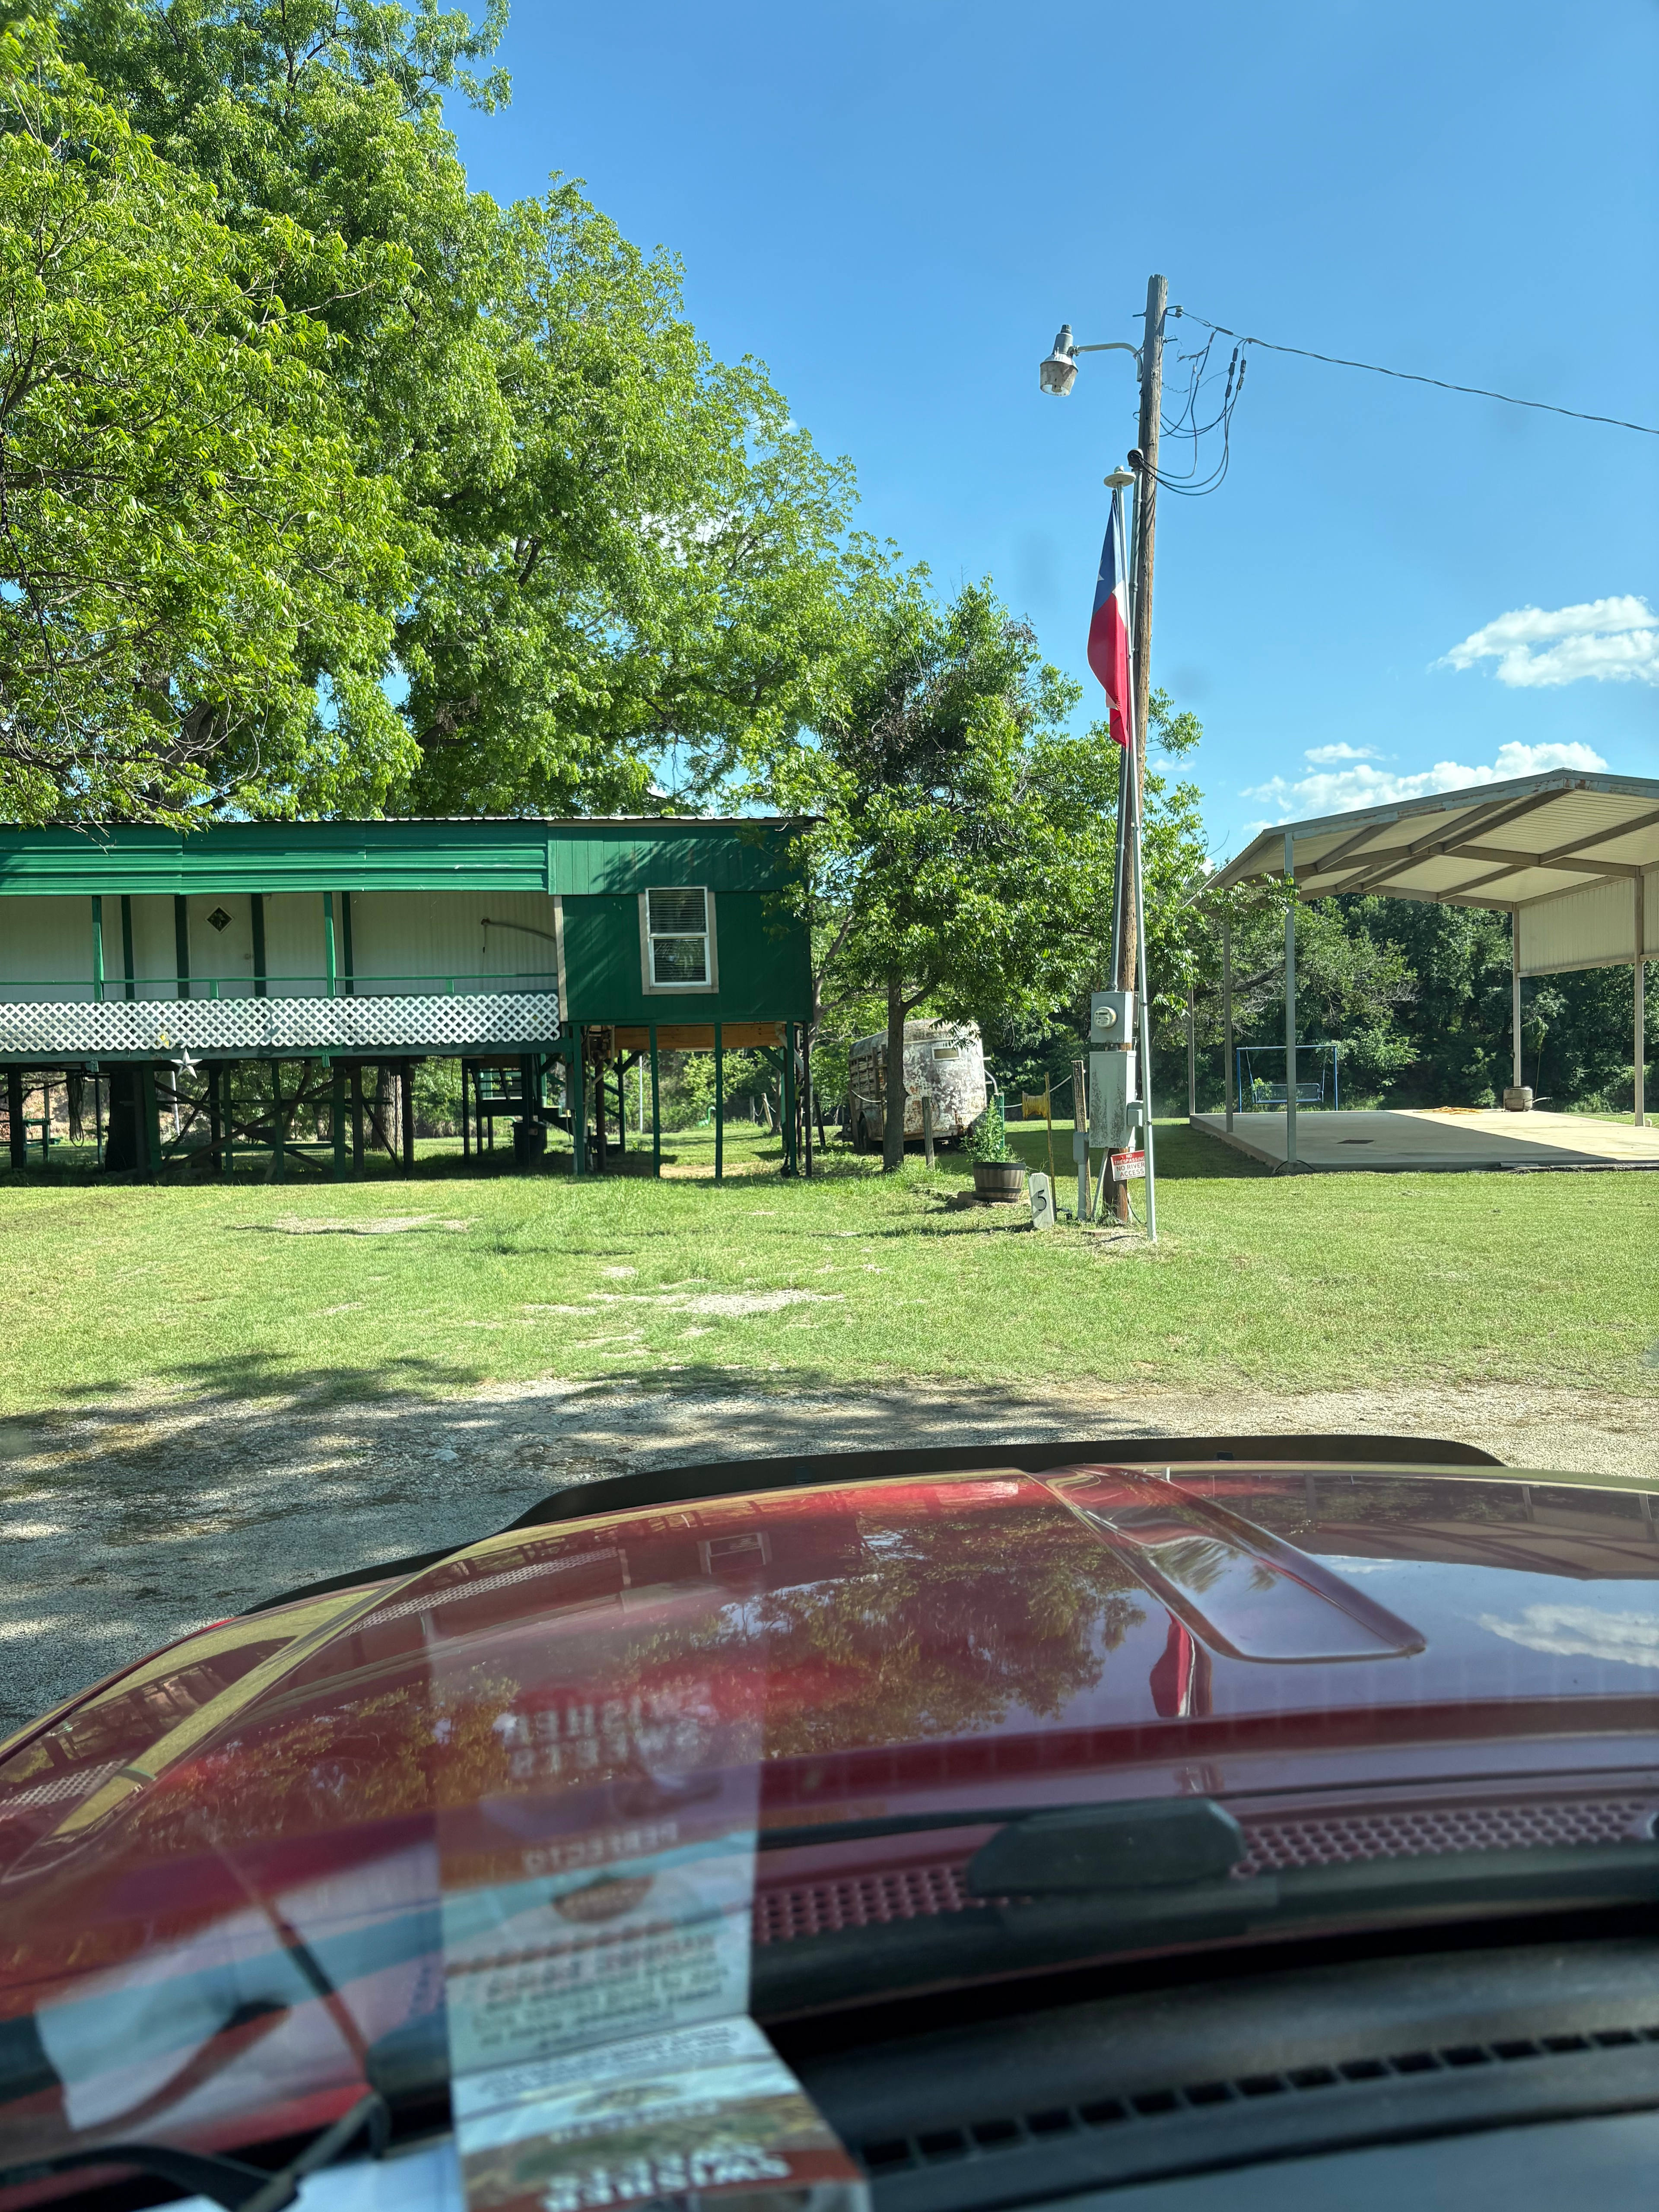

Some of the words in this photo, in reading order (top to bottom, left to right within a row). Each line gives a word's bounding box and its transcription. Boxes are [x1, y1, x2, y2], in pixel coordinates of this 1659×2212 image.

[1115, 1156, 1144, 1165] TRESPASSING
[1120, 1169, 1144, 1178] ACCESS
[1038, 1189, 1047, 1211] 5
